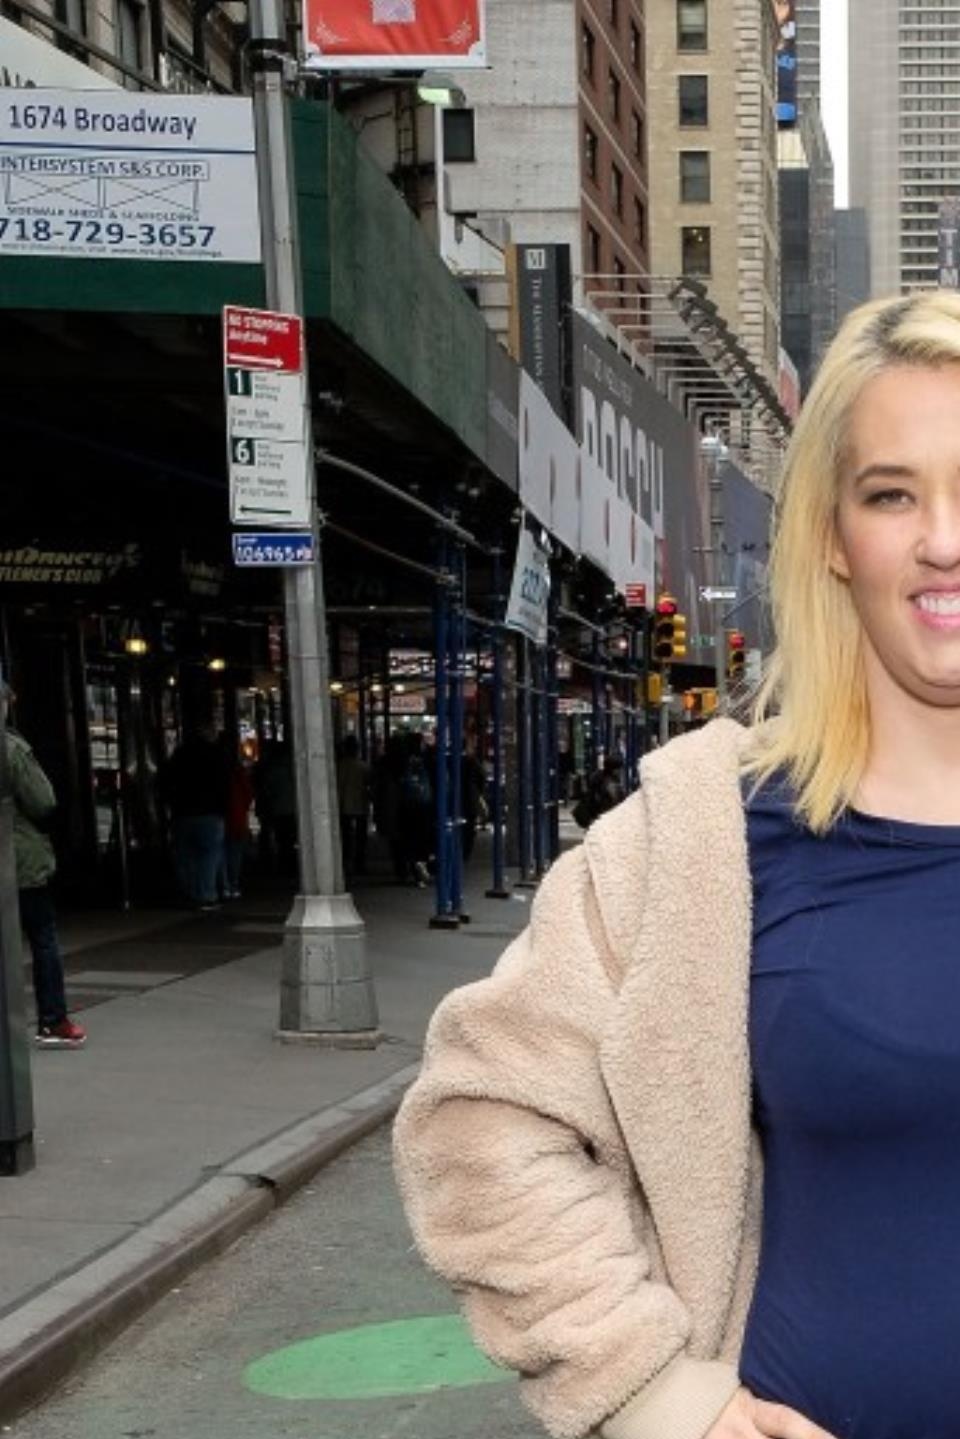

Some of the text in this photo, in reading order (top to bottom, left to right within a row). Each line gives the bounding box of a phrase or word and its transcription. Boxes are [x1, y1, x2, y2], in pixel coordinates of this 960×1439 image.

[9, 104, 198, 140] 1674 Broadway
[119, 160, 151, 176] S&S
[156, 162, 206, 179] CORP.
[0, 217, 216, 248] 718-729-3657
[235, 439, 251, 464] 6
